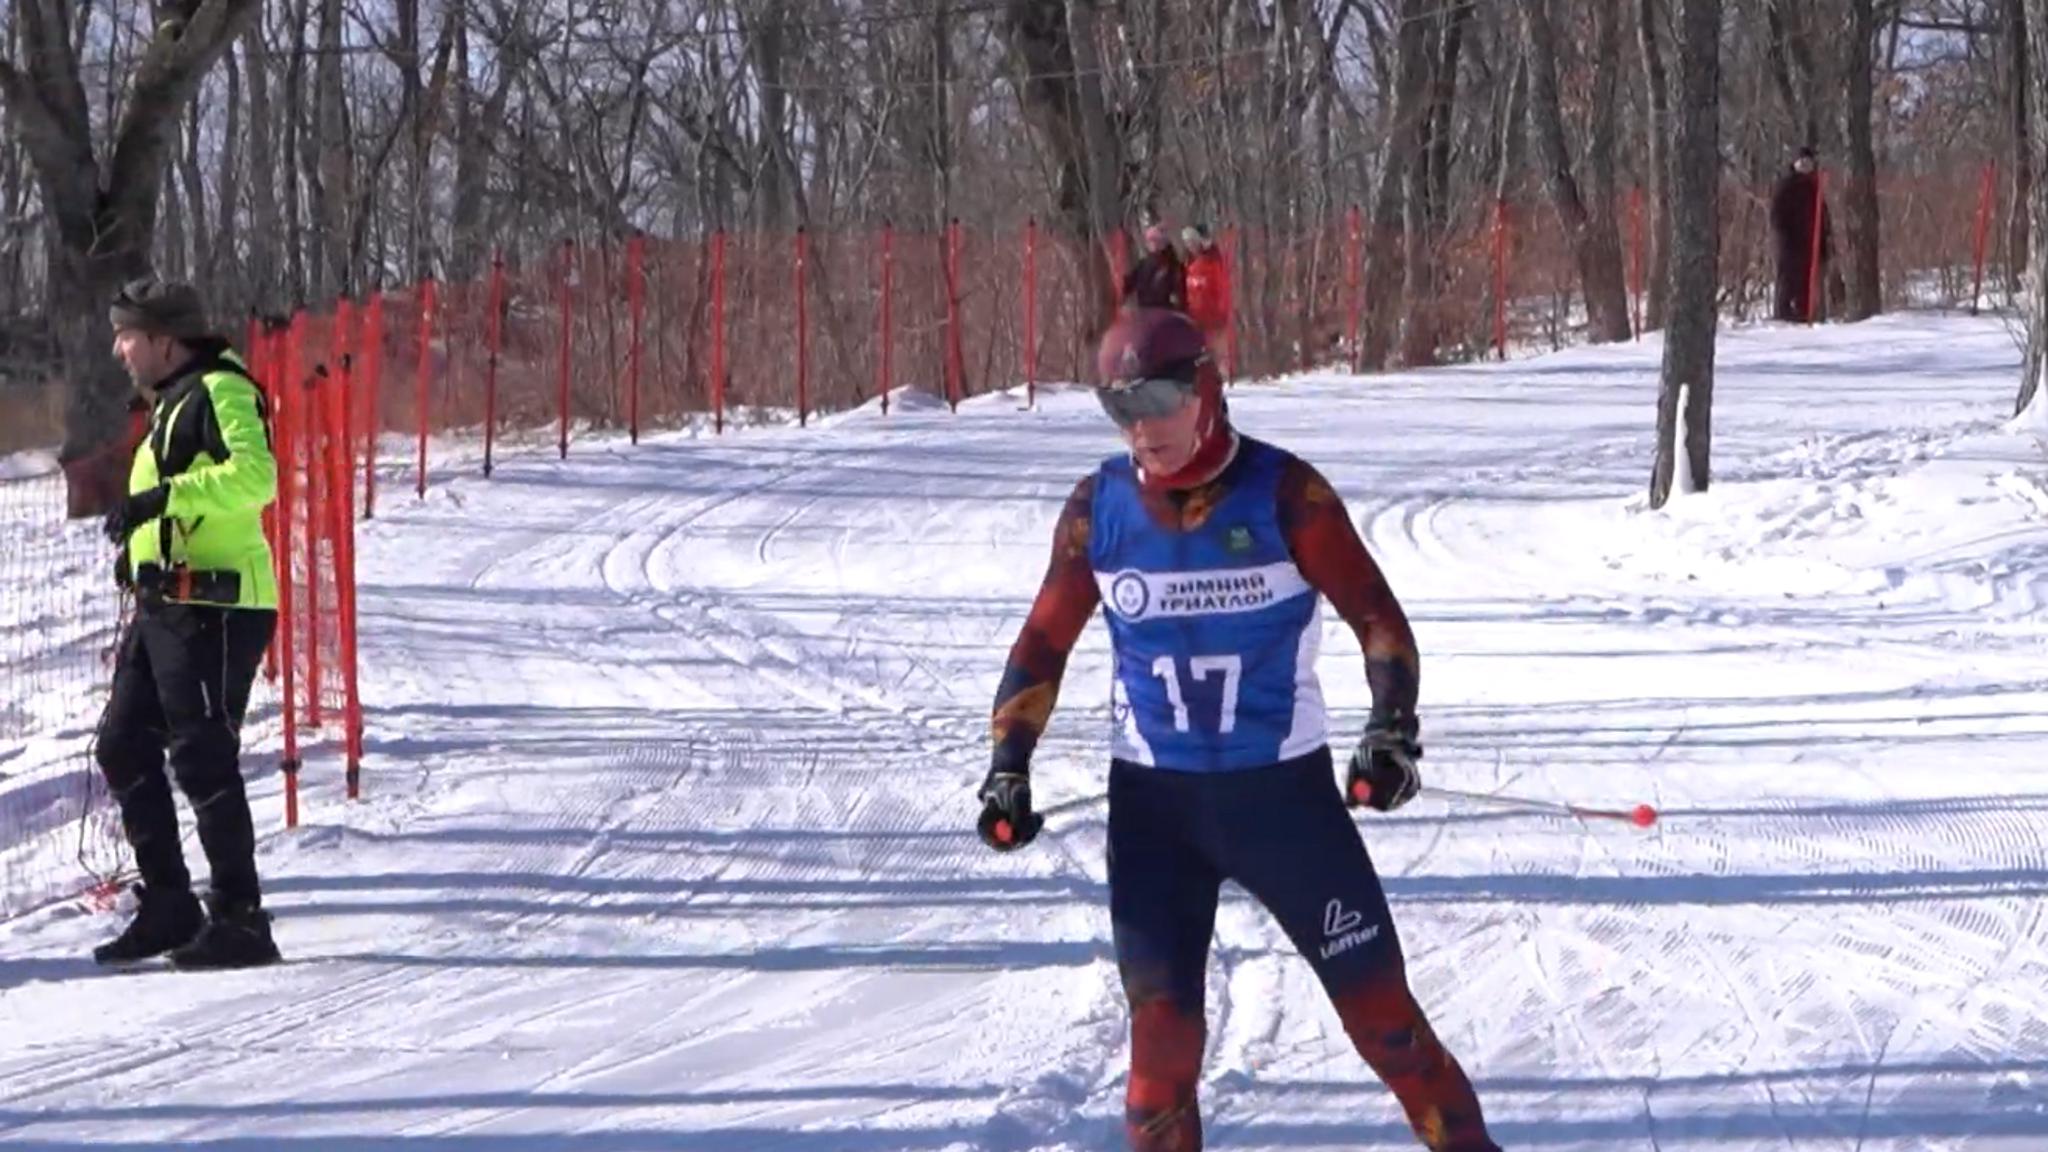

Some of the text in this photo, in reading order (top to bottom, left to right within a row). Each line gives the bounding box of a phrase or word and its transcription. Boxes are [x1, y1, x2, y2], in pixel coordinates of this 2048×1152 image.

[1165, 573, 1266, 595] ЗИМНИЙ
[1160, 589, 1273, 612] ТРИАТЛОН
[1152, 655, 1242, 733] 17
